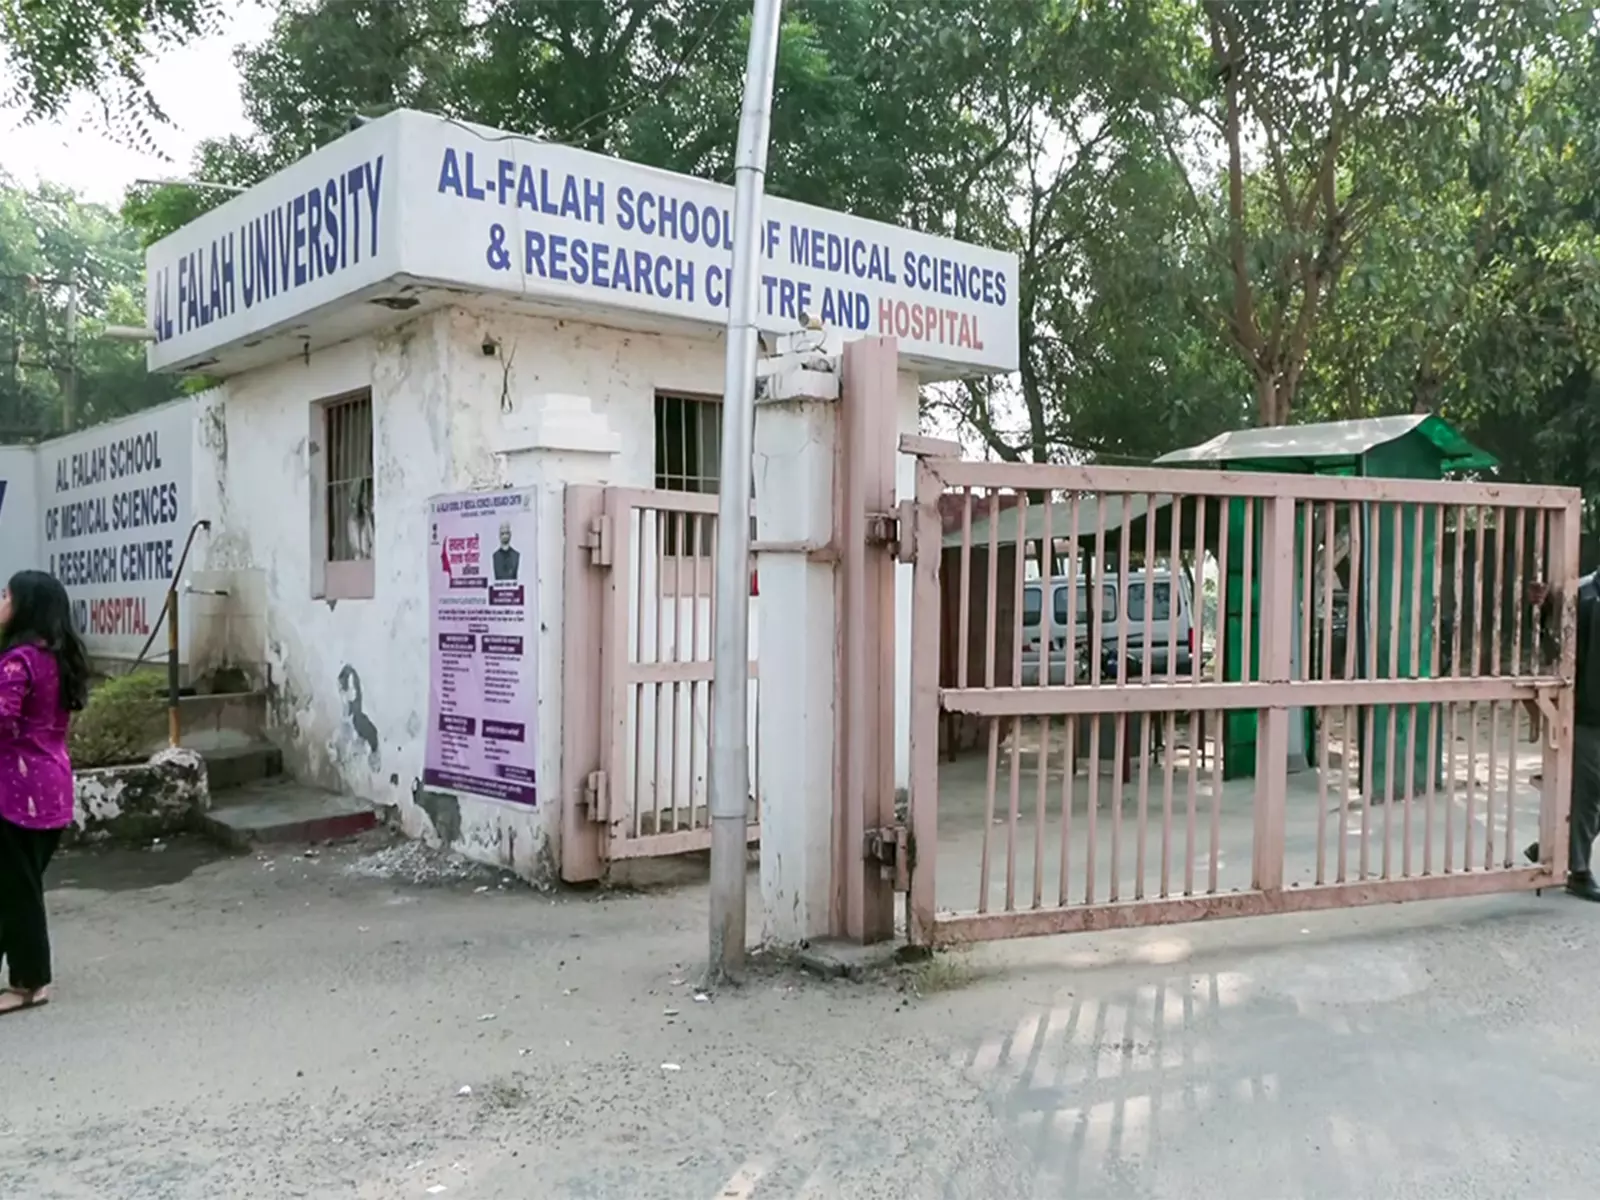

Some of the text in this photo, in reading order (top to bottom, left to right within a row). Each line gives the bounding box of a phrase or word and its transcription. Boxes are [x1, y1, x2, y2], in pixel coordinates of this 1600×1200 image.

[153, 154, 384, 345] AL FALAH UNIVERSITY
[437, 147, 1007, 307] AL-FALAH SCHOOL F MEDICAL SCIENCES
[486, 223, 984, 351] & RESEARCH CTRE AND HOSPITAL
[55, 430, 162, 493] AL FALAH SCHOOL
[45, 481, 178, 541] OF MEDICAL SCIENCES
[59, 547, 117, 586] RESEARCH
[120, 539, 174, 582] CENTRE
[72, 596, 150, 635] ND HOSPITAL
